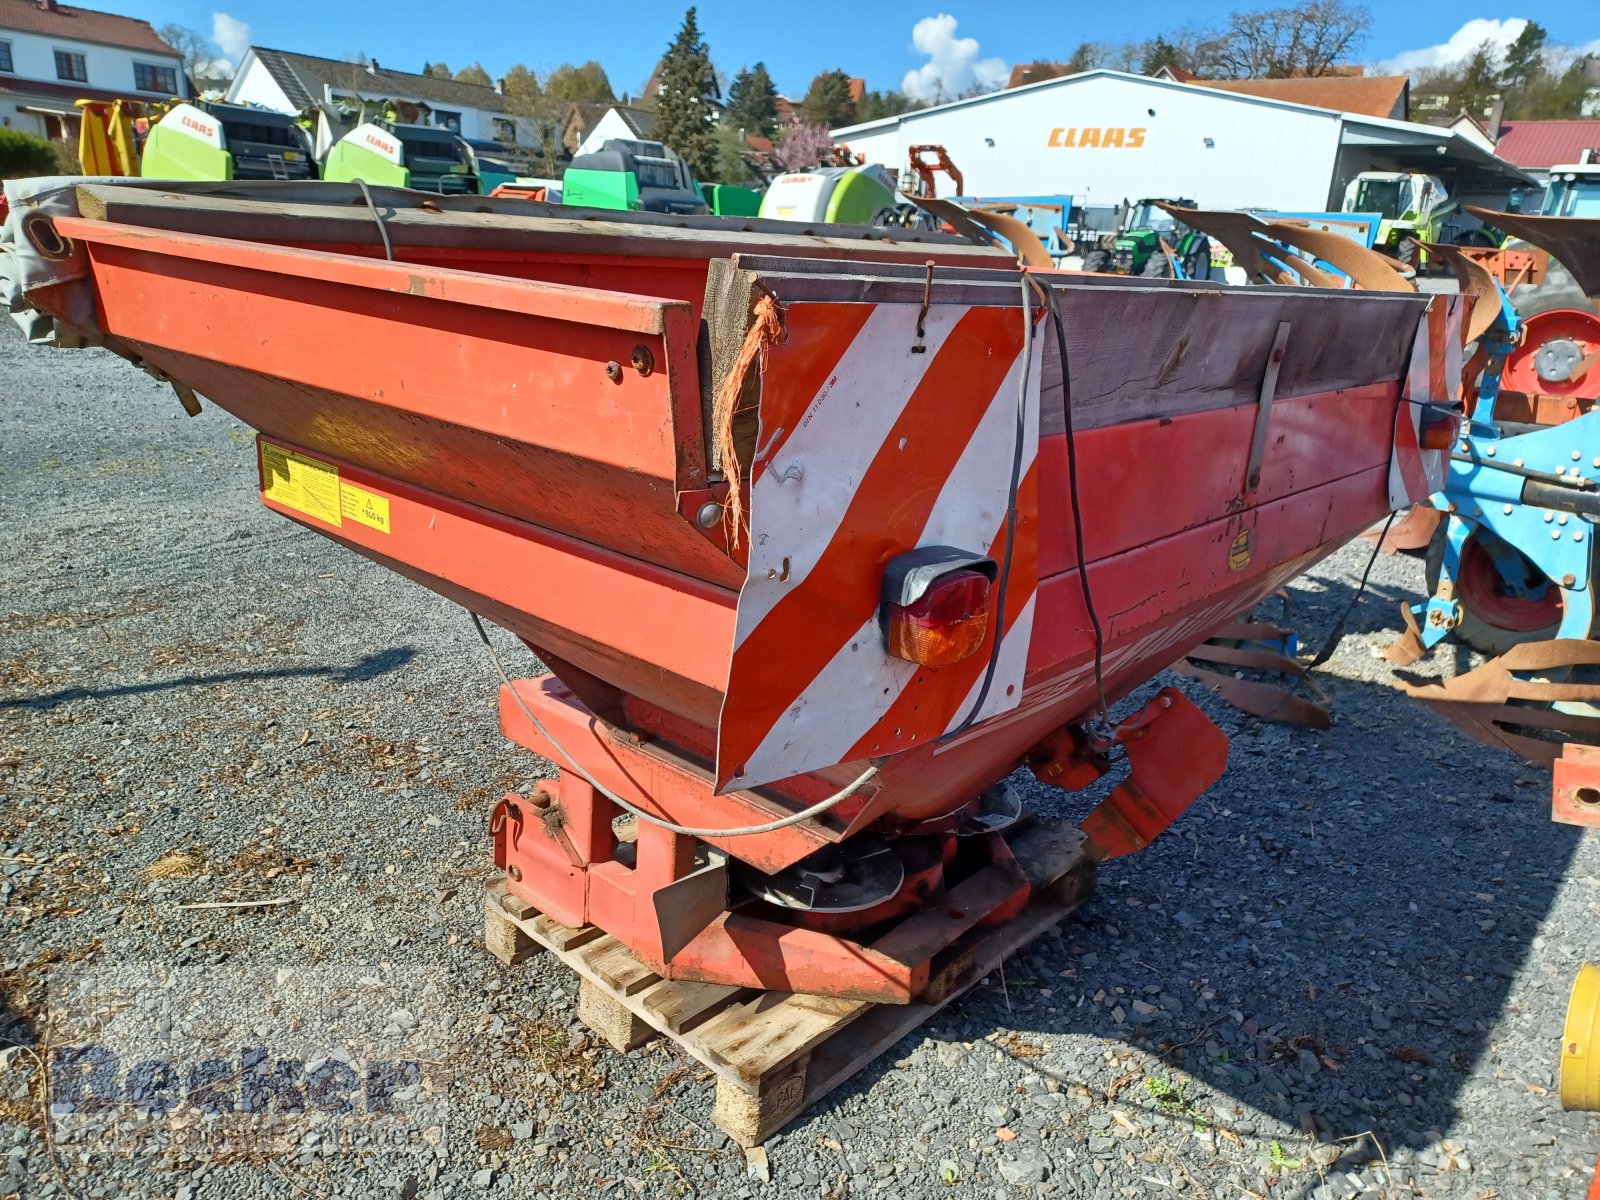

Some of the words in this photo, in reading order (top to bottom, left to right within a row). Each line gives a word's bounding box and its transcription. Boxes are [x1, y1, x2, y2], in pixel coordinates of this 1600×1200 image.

[182, 116, 214, 137] CLAAS
[366, 134, 395, 155] CLAAS
[1048, 128, 1147, 148] CLAAS
[802, 413, 813, 428] DIN
